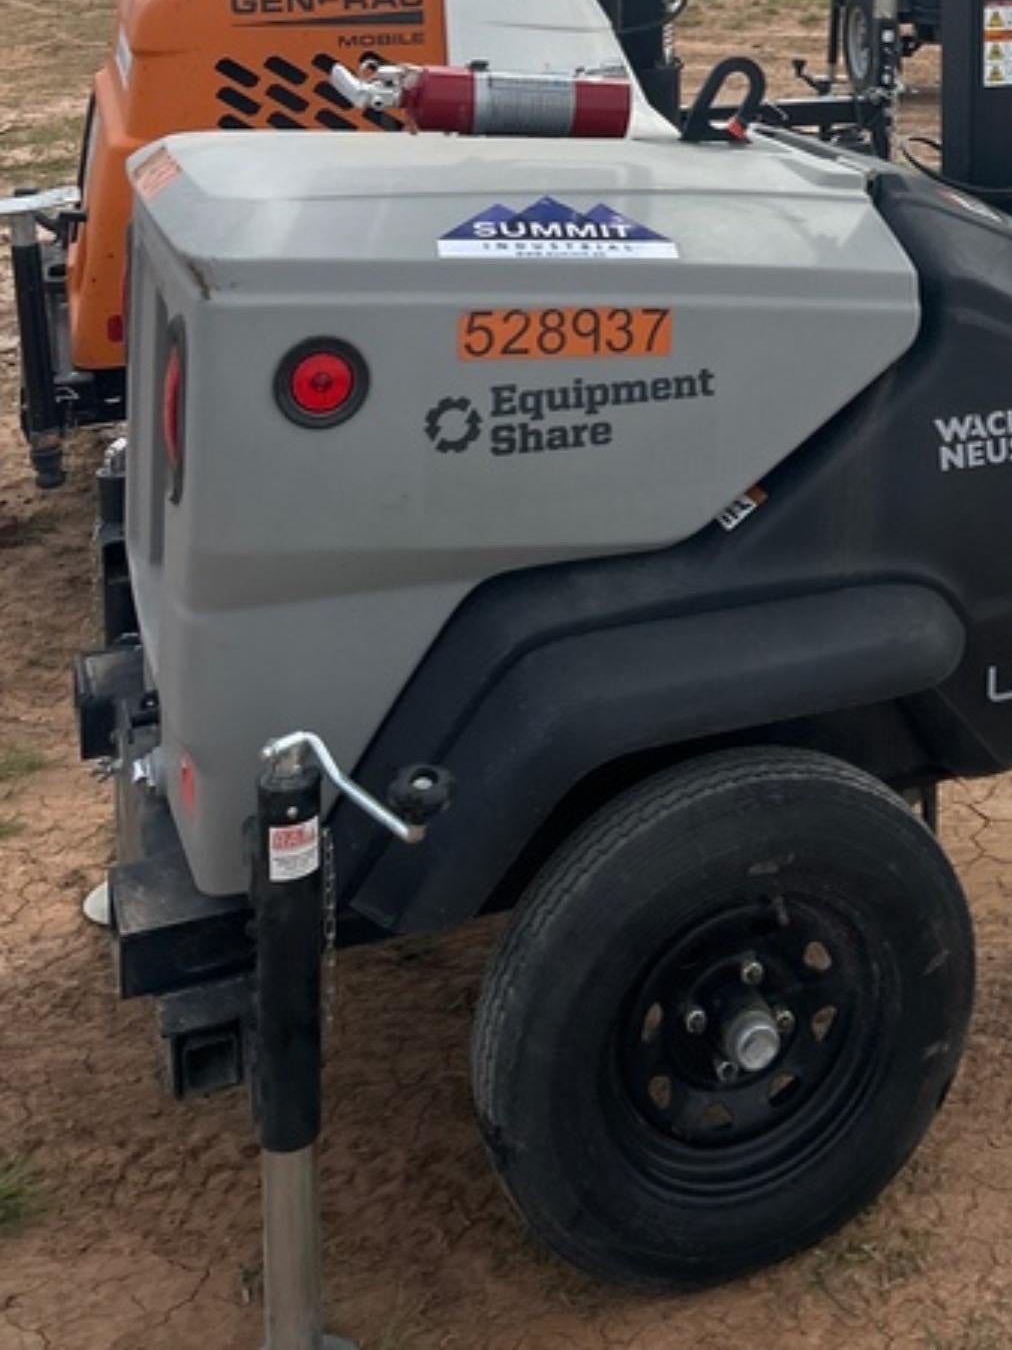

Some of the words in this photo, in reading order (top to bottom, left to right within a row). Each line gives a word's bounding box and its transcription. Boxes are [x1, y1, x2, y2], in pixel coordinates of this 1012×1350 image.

[338, 33, 425, 47] MOBILE
[473, 221, 632, 239] SUMMIT
[463, 308, 671, 357] 528937
[490, 368, 715, 421] Equipment
[490, 420, 613, 457] Share
